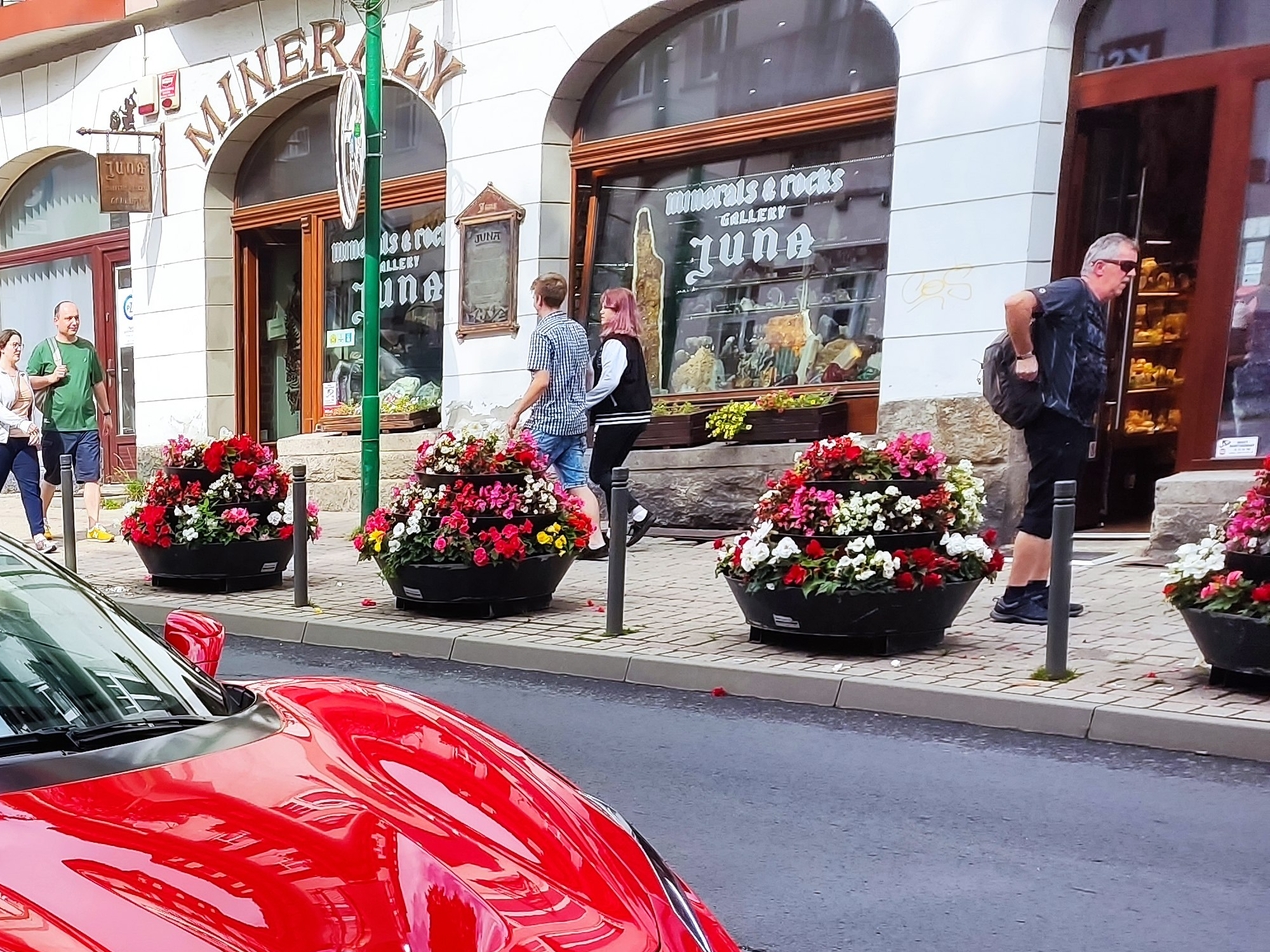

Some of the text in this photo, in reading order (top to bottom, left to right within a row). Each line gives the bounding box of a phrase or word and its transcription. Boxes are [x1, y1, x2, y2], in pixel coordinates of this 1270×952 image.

[761, 176, 777, 202] &
[719, 205, 787, 227] GALLERY
[475, 231, 501, 244] JUNA
[380, 255, 420, 274] ALLERY
